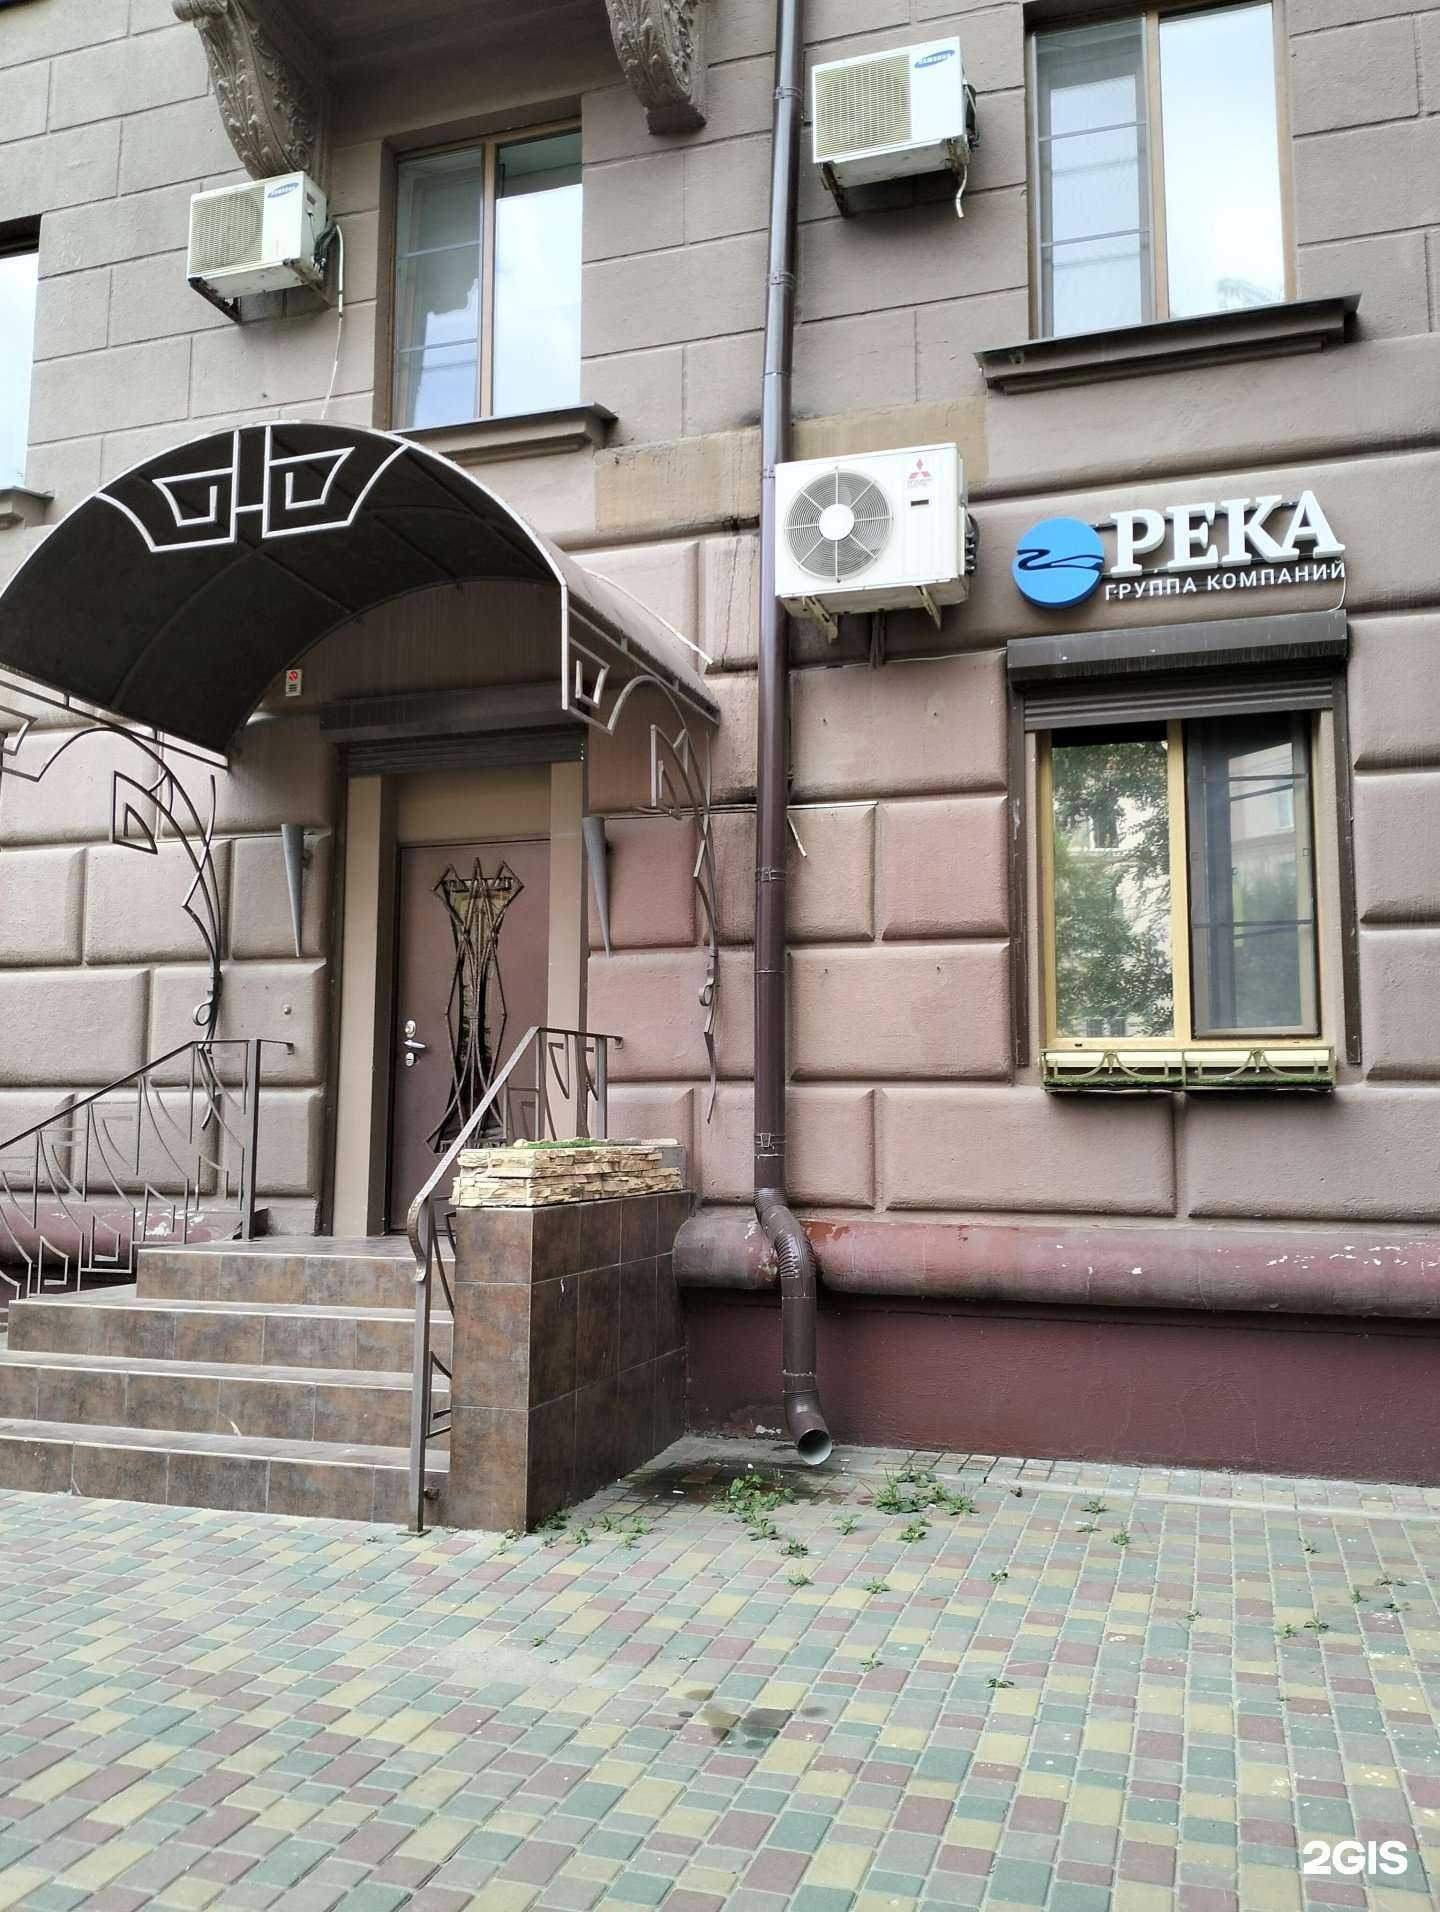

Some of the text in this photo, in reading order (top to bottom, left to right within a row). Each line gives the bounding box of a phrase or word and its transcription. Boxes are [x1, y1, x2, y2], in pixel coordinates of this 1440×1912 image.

[1110, 489, 1346, 578] РЕКА
[1105, 560, 1346, 601] ГРУППА КОМПАНИЙ
